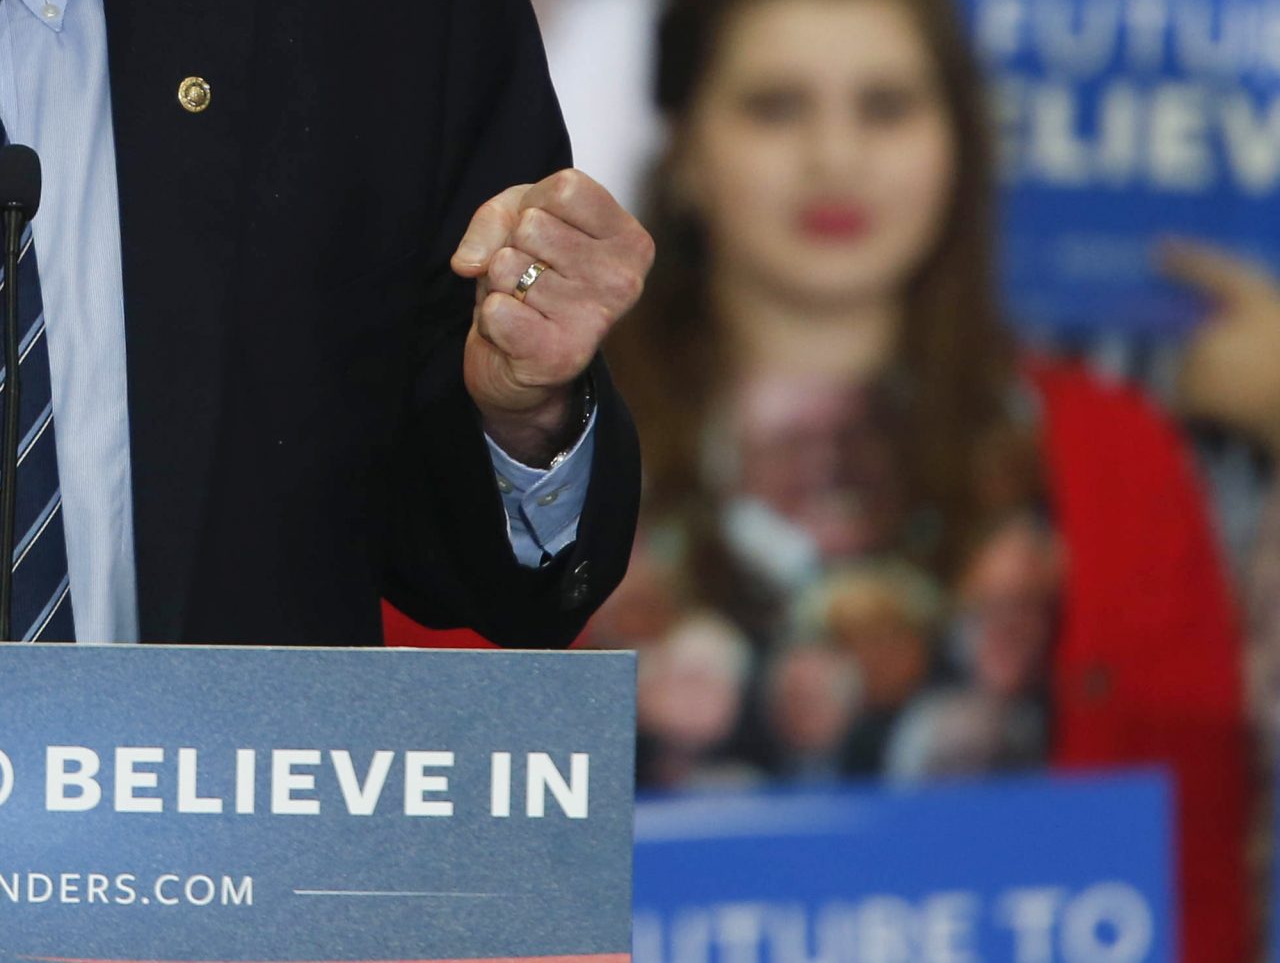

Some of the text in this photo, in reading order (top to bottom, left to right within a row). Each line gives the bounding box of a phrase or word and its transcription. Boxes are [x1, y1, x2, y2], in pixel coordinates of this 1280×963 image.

[45, 745, 455, 817] BELIEVE
[491, 752, 589, 819] IN
[633, 890, 980, 963] UTURE
